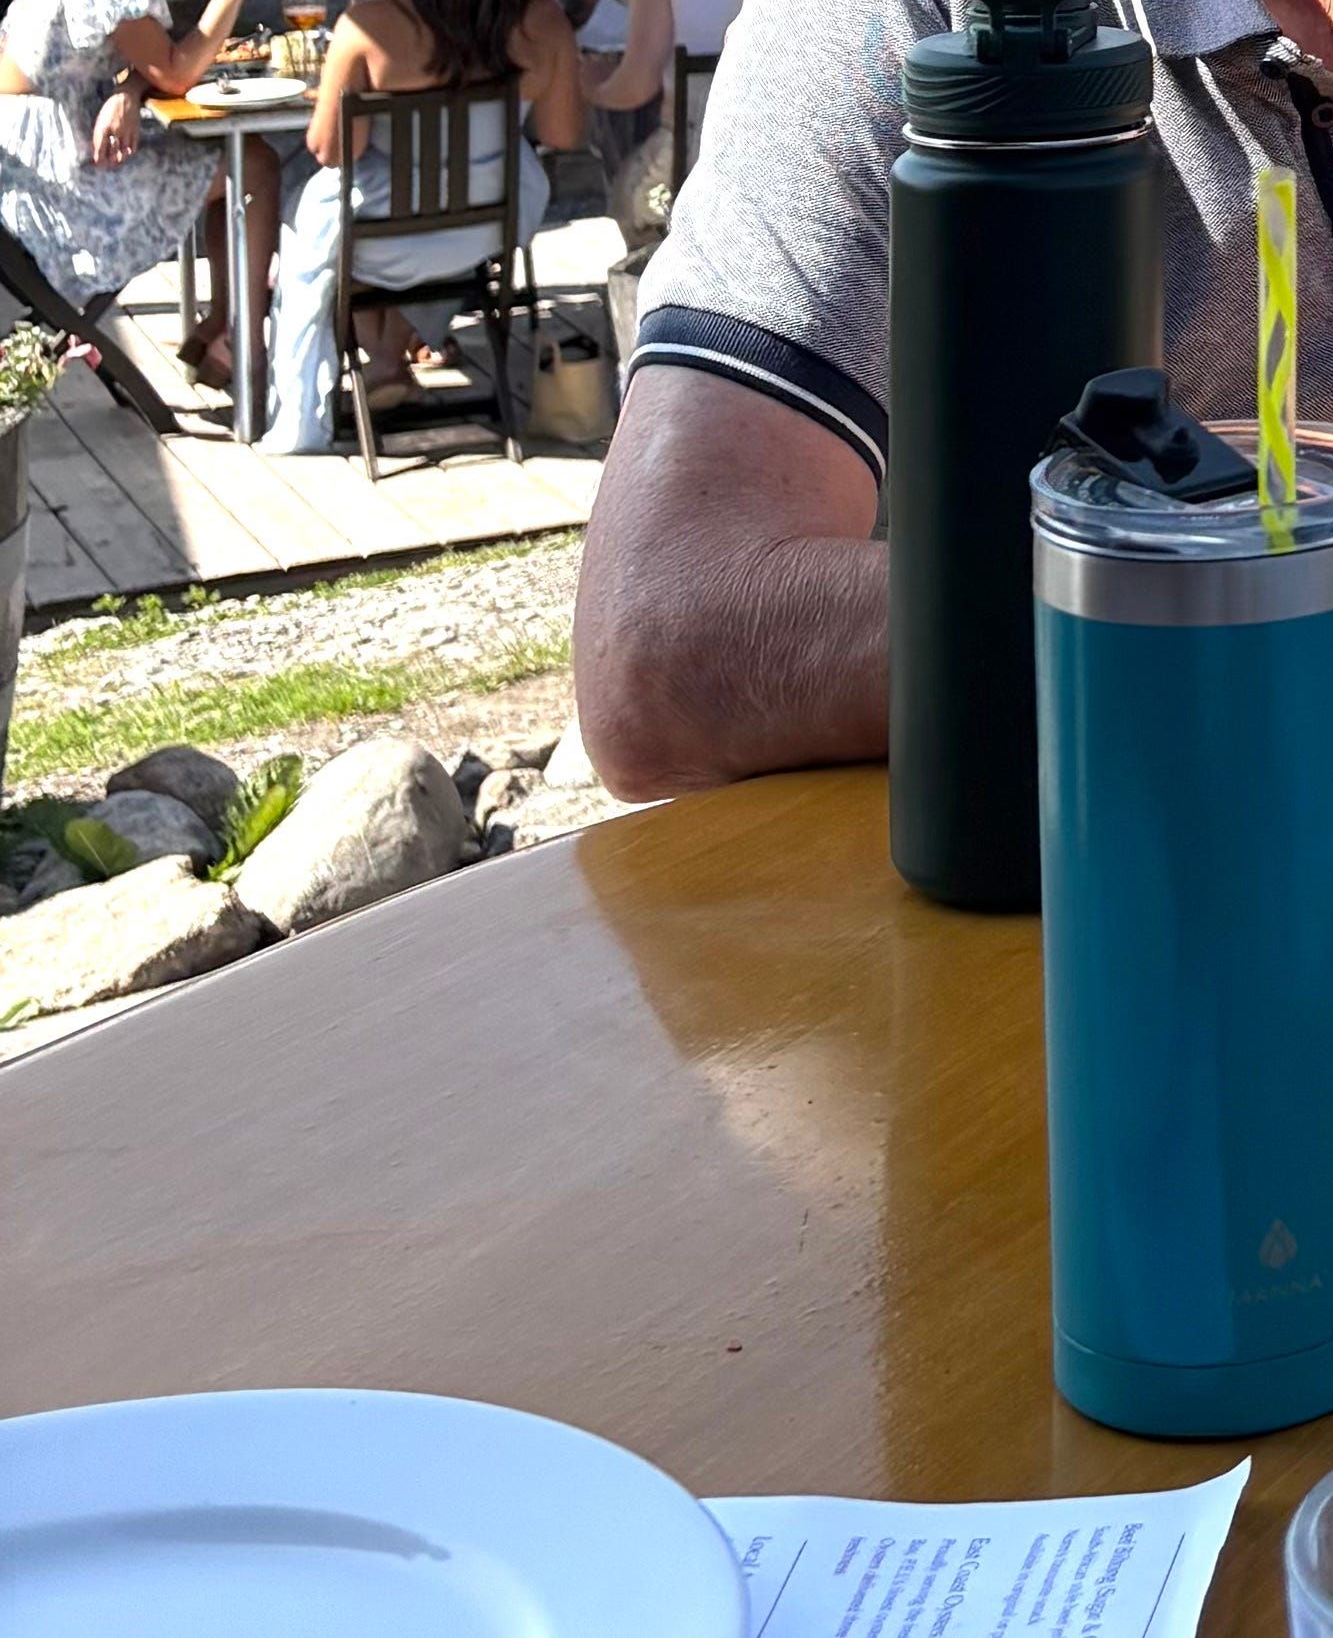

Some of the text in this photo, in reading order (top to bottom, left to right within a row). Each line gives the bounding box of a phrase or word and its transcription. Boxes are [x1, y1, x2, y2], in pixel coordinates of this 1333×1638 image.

[1117, 1523, 1144, 1545] Beef
[963, 1538, 992, 1560] East
[948, 1561, 981, 1593] Coast
[1095, 1546, 1135, 1585] Biltong
